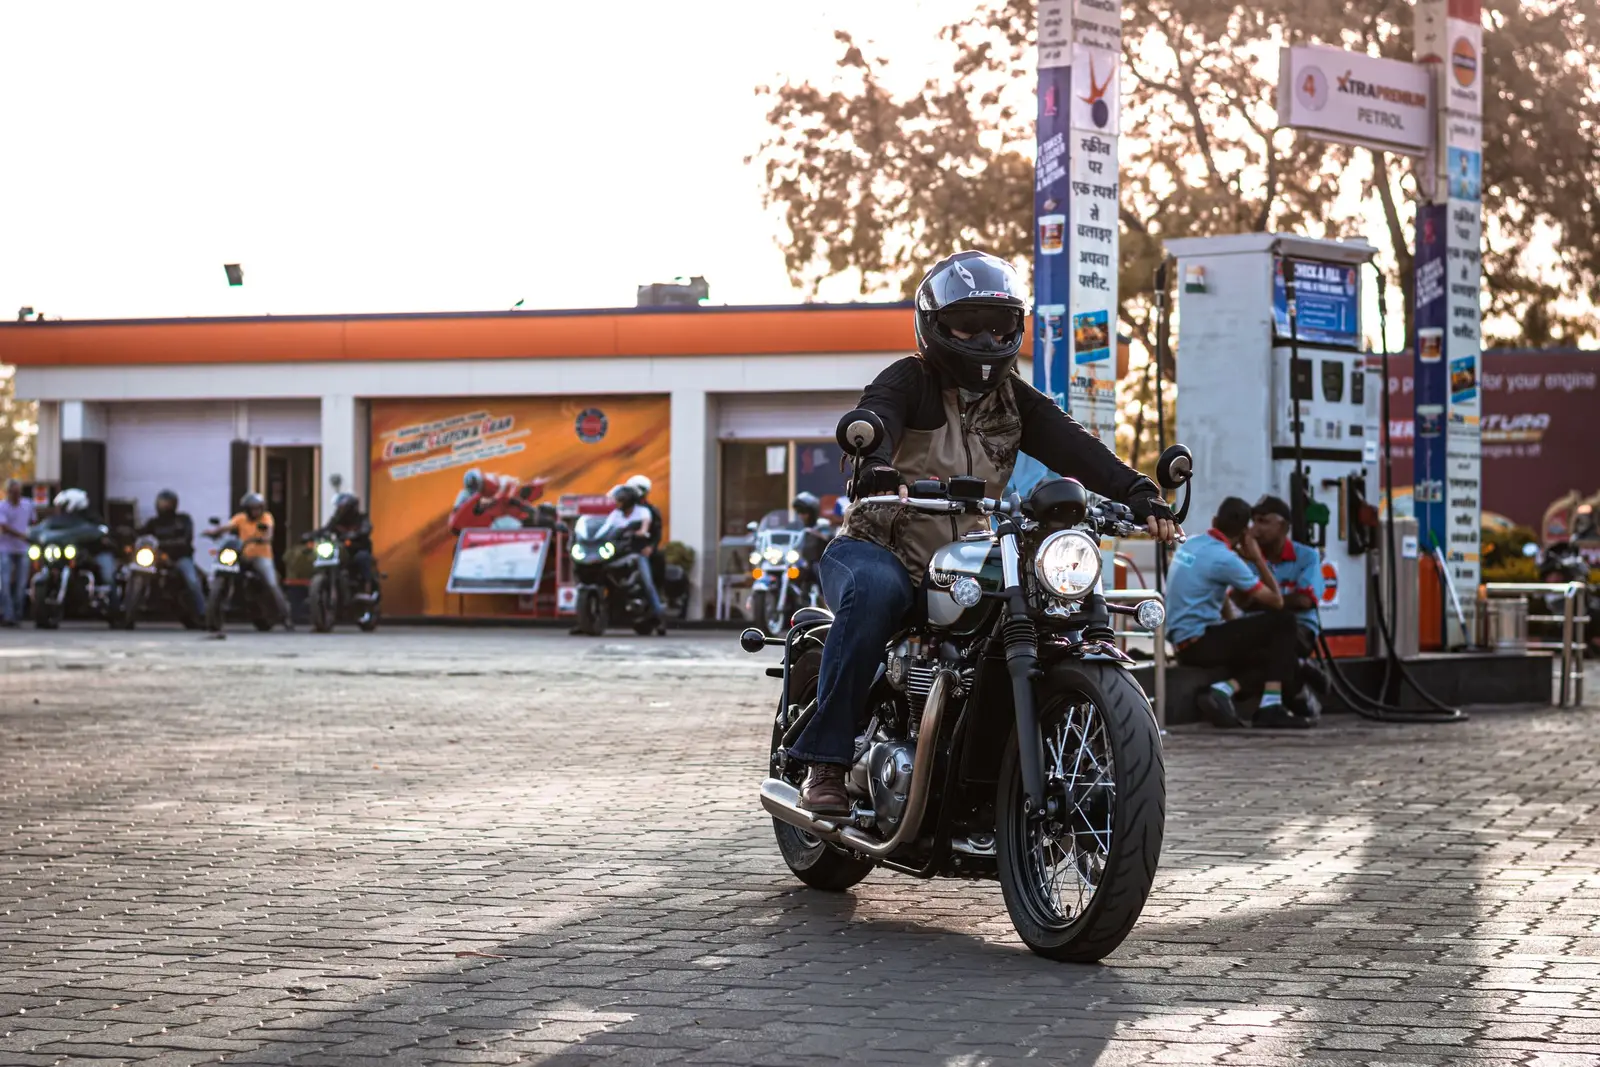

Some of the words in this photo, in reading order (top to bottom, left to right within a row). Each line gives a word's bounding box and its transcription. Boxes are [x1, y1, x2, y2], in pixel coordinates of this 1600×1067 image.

[1303, 74, 1315, 97] 4
[1358, 107, 1404, 130] PETROL
[1088, 160, 1103, 174] पर
[1072, 181, 1090, 196] एक
[1089, 203, 1099, 221] से
[1079, 251, 1109, 267] अपना
[1506, 374, 1541, 394] your
[1545, 373, 1596, 393] engine
